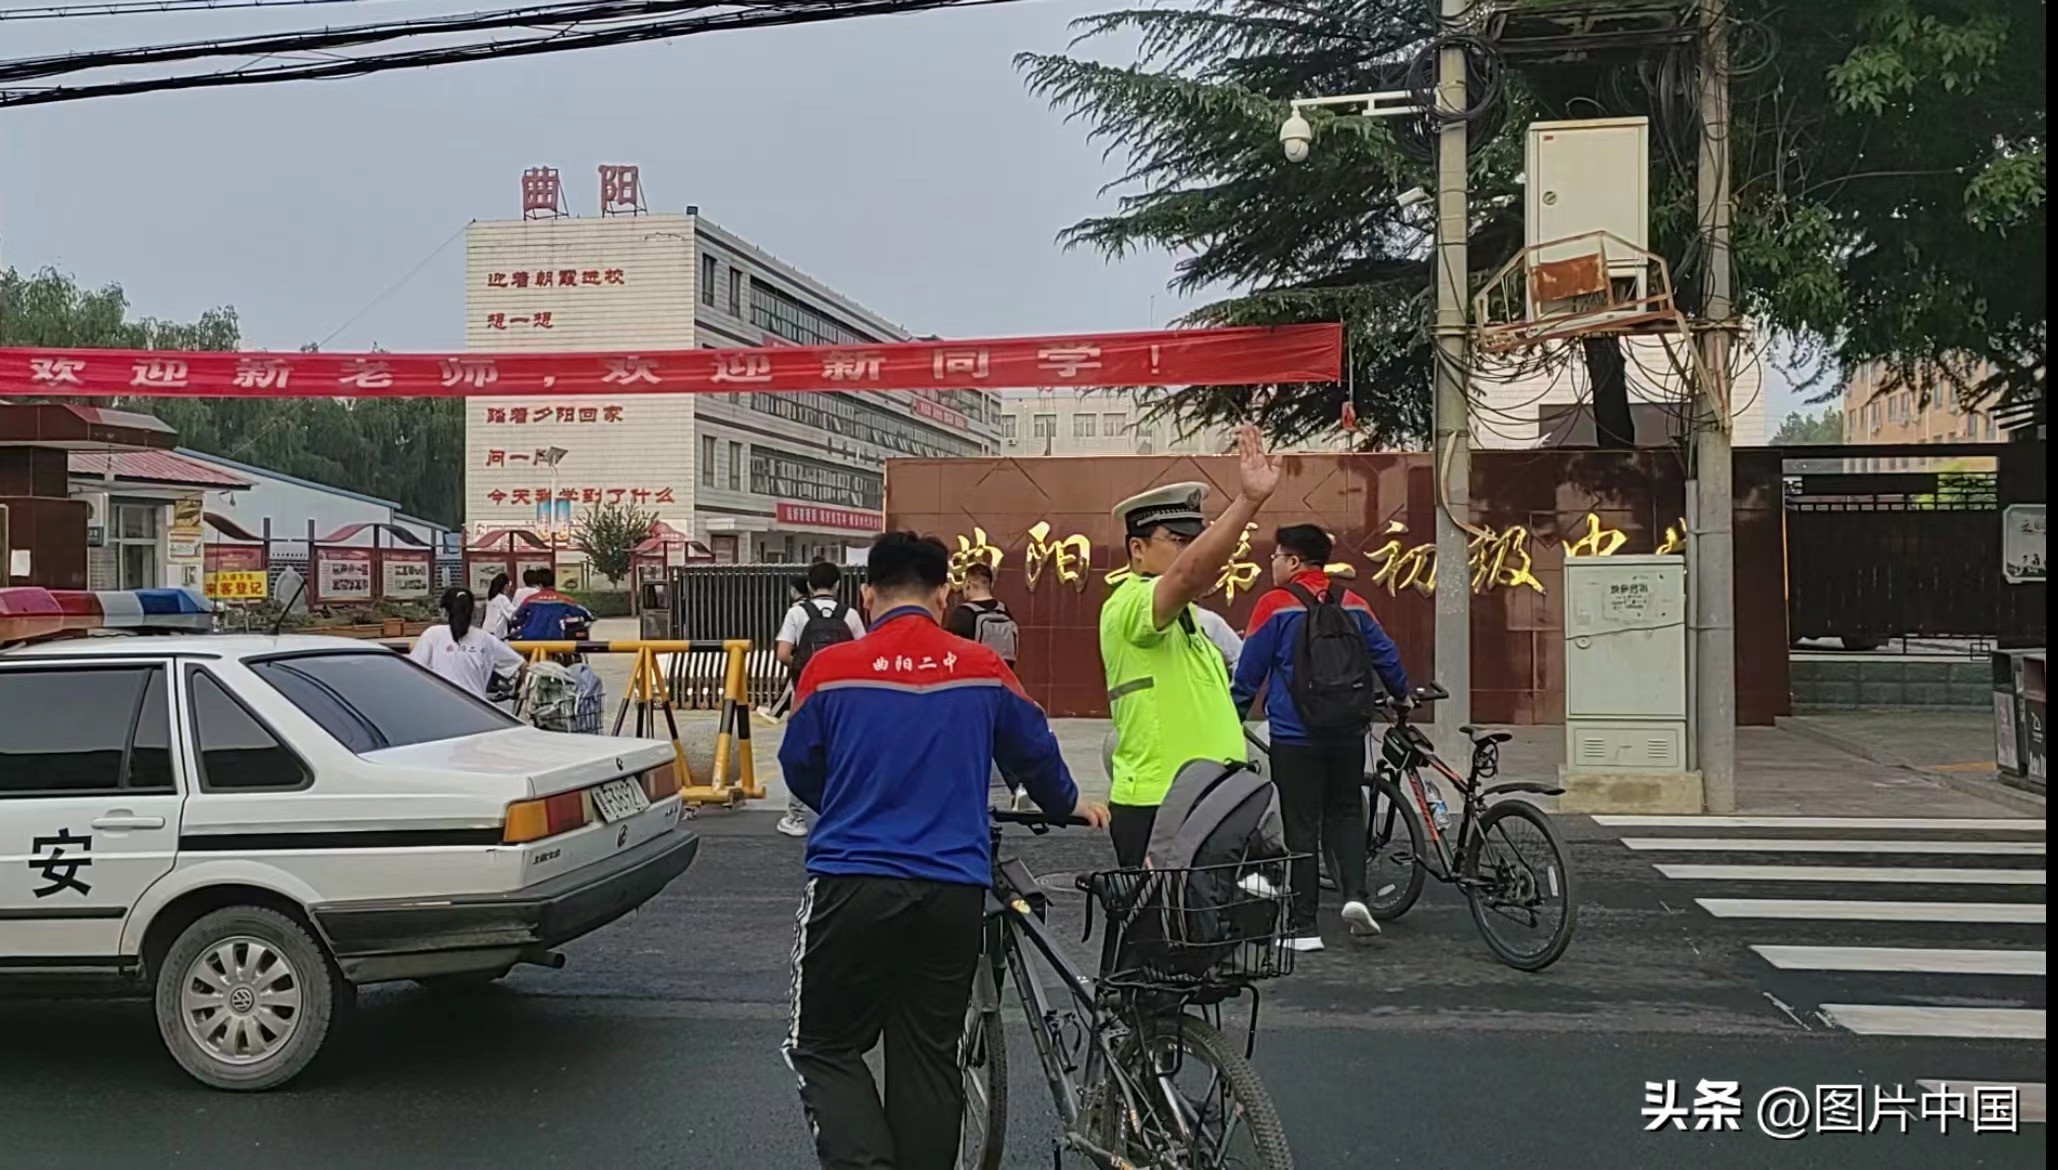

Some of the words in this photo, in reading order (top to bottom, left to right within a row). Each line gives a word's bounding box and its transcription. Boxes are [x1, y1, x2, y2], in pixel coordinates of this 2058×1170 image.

[487, 268, 625, 288] 迎着朝霞进校
[487, 311, 554, 330] 想一想
[487, 405, 623, 424] 踏着夕阳回家
[873, 651, 957, 674] 曲阳二中
[28, 828, 92, 898] 安
